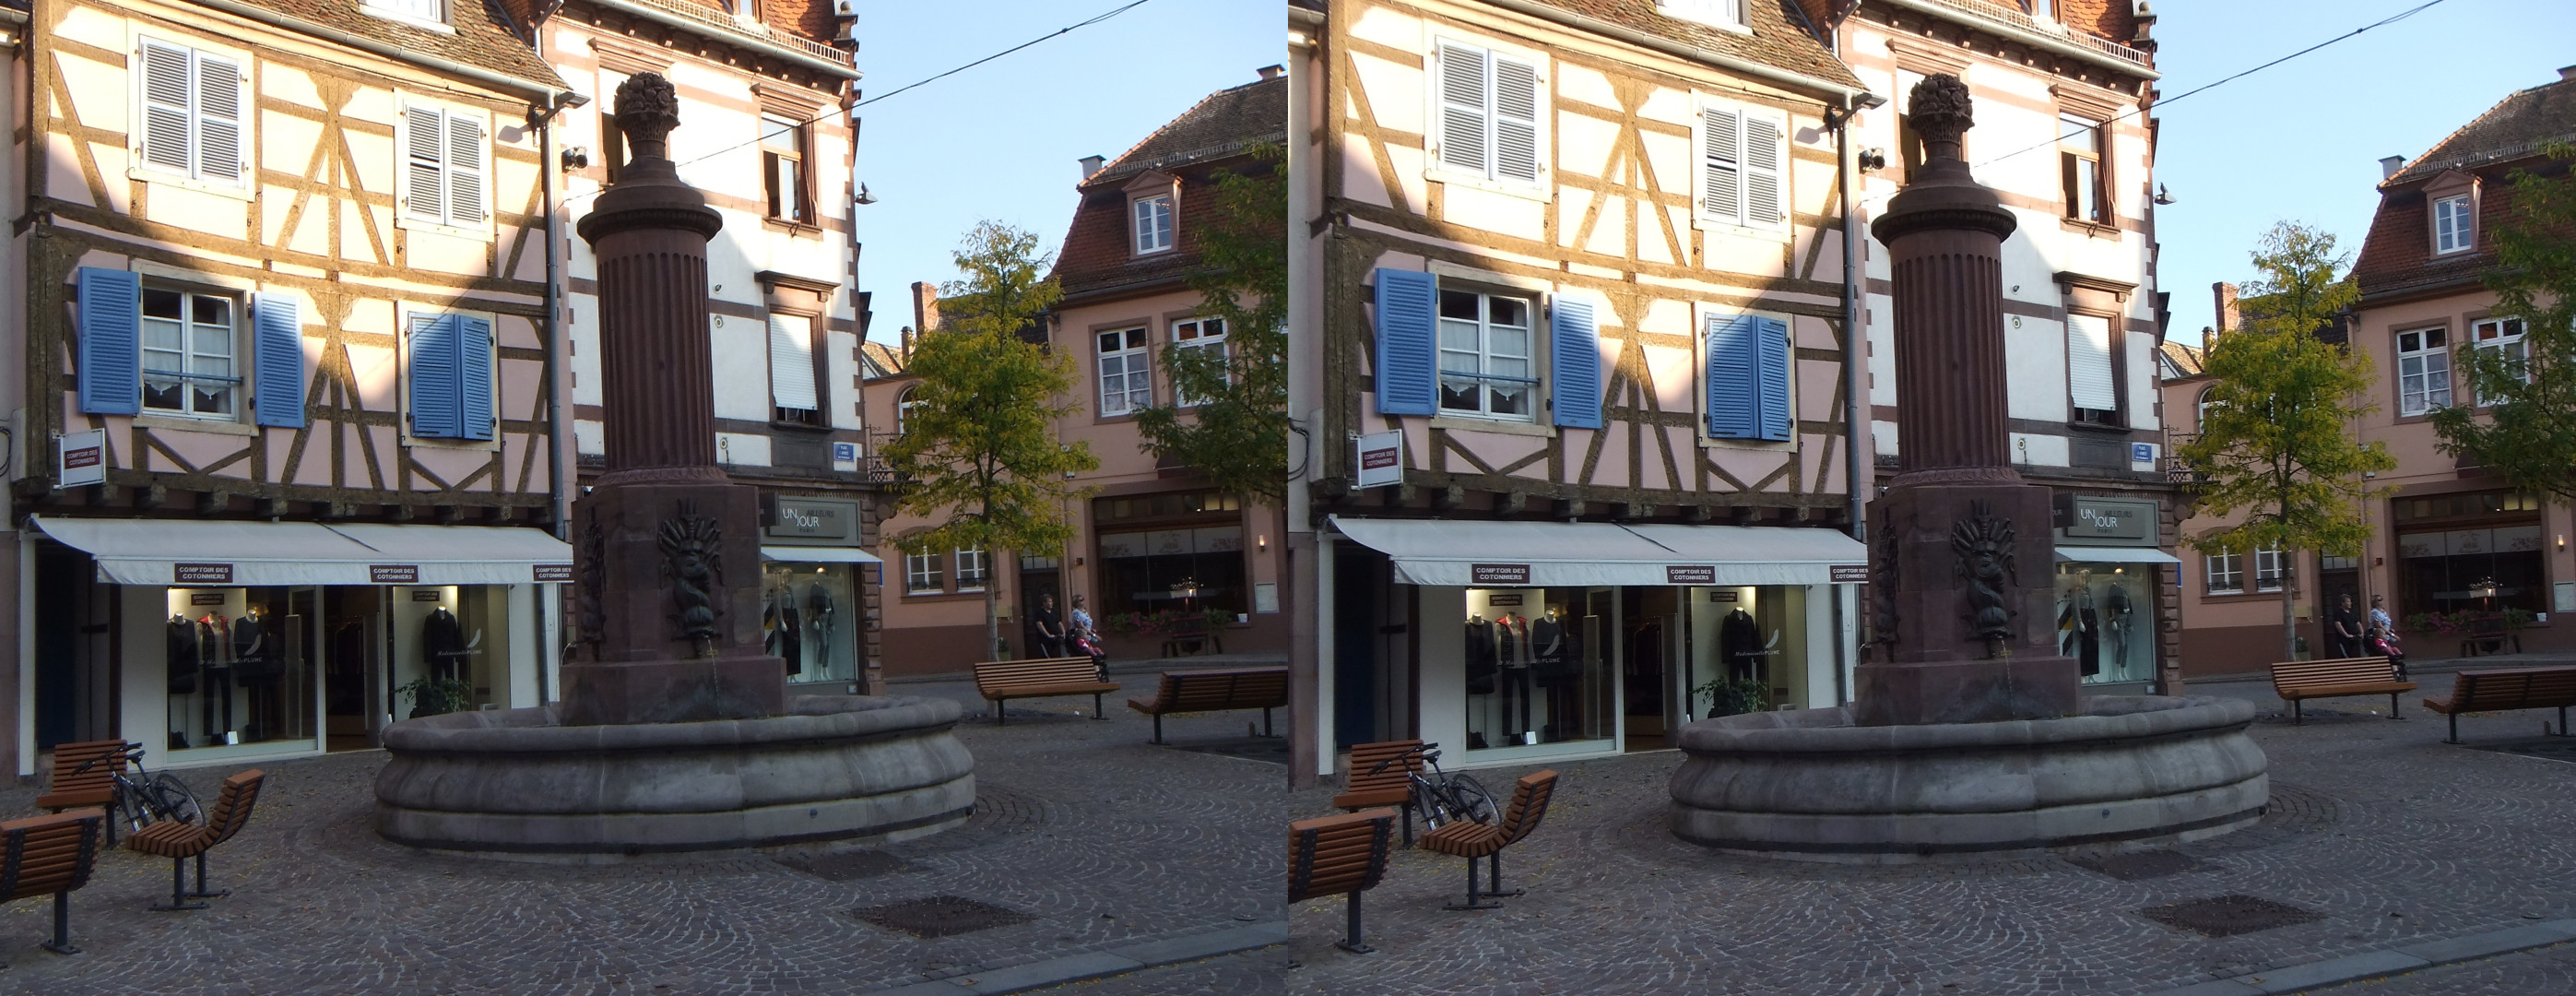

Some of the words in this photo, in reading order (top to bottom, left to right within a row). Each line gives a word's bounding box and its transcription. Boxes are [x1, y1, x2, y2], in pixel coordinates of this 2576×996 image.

[66, 450, 89, 459] COMPTOIR
[1365, 451, 1386, 460] COMPTOIR
[69, 456, 96, 466] COTONNIERS
[1366, 457, 1393, 467] COTONNIERS
[782, 508, 798, 519] UN
[2080, 508, 2096, 519] UN
[2104, 509, 2133, 518] AILLEURS
[796, 516, 820, 528] JOUR
[2094, 516, 2118, 528] JOUR
